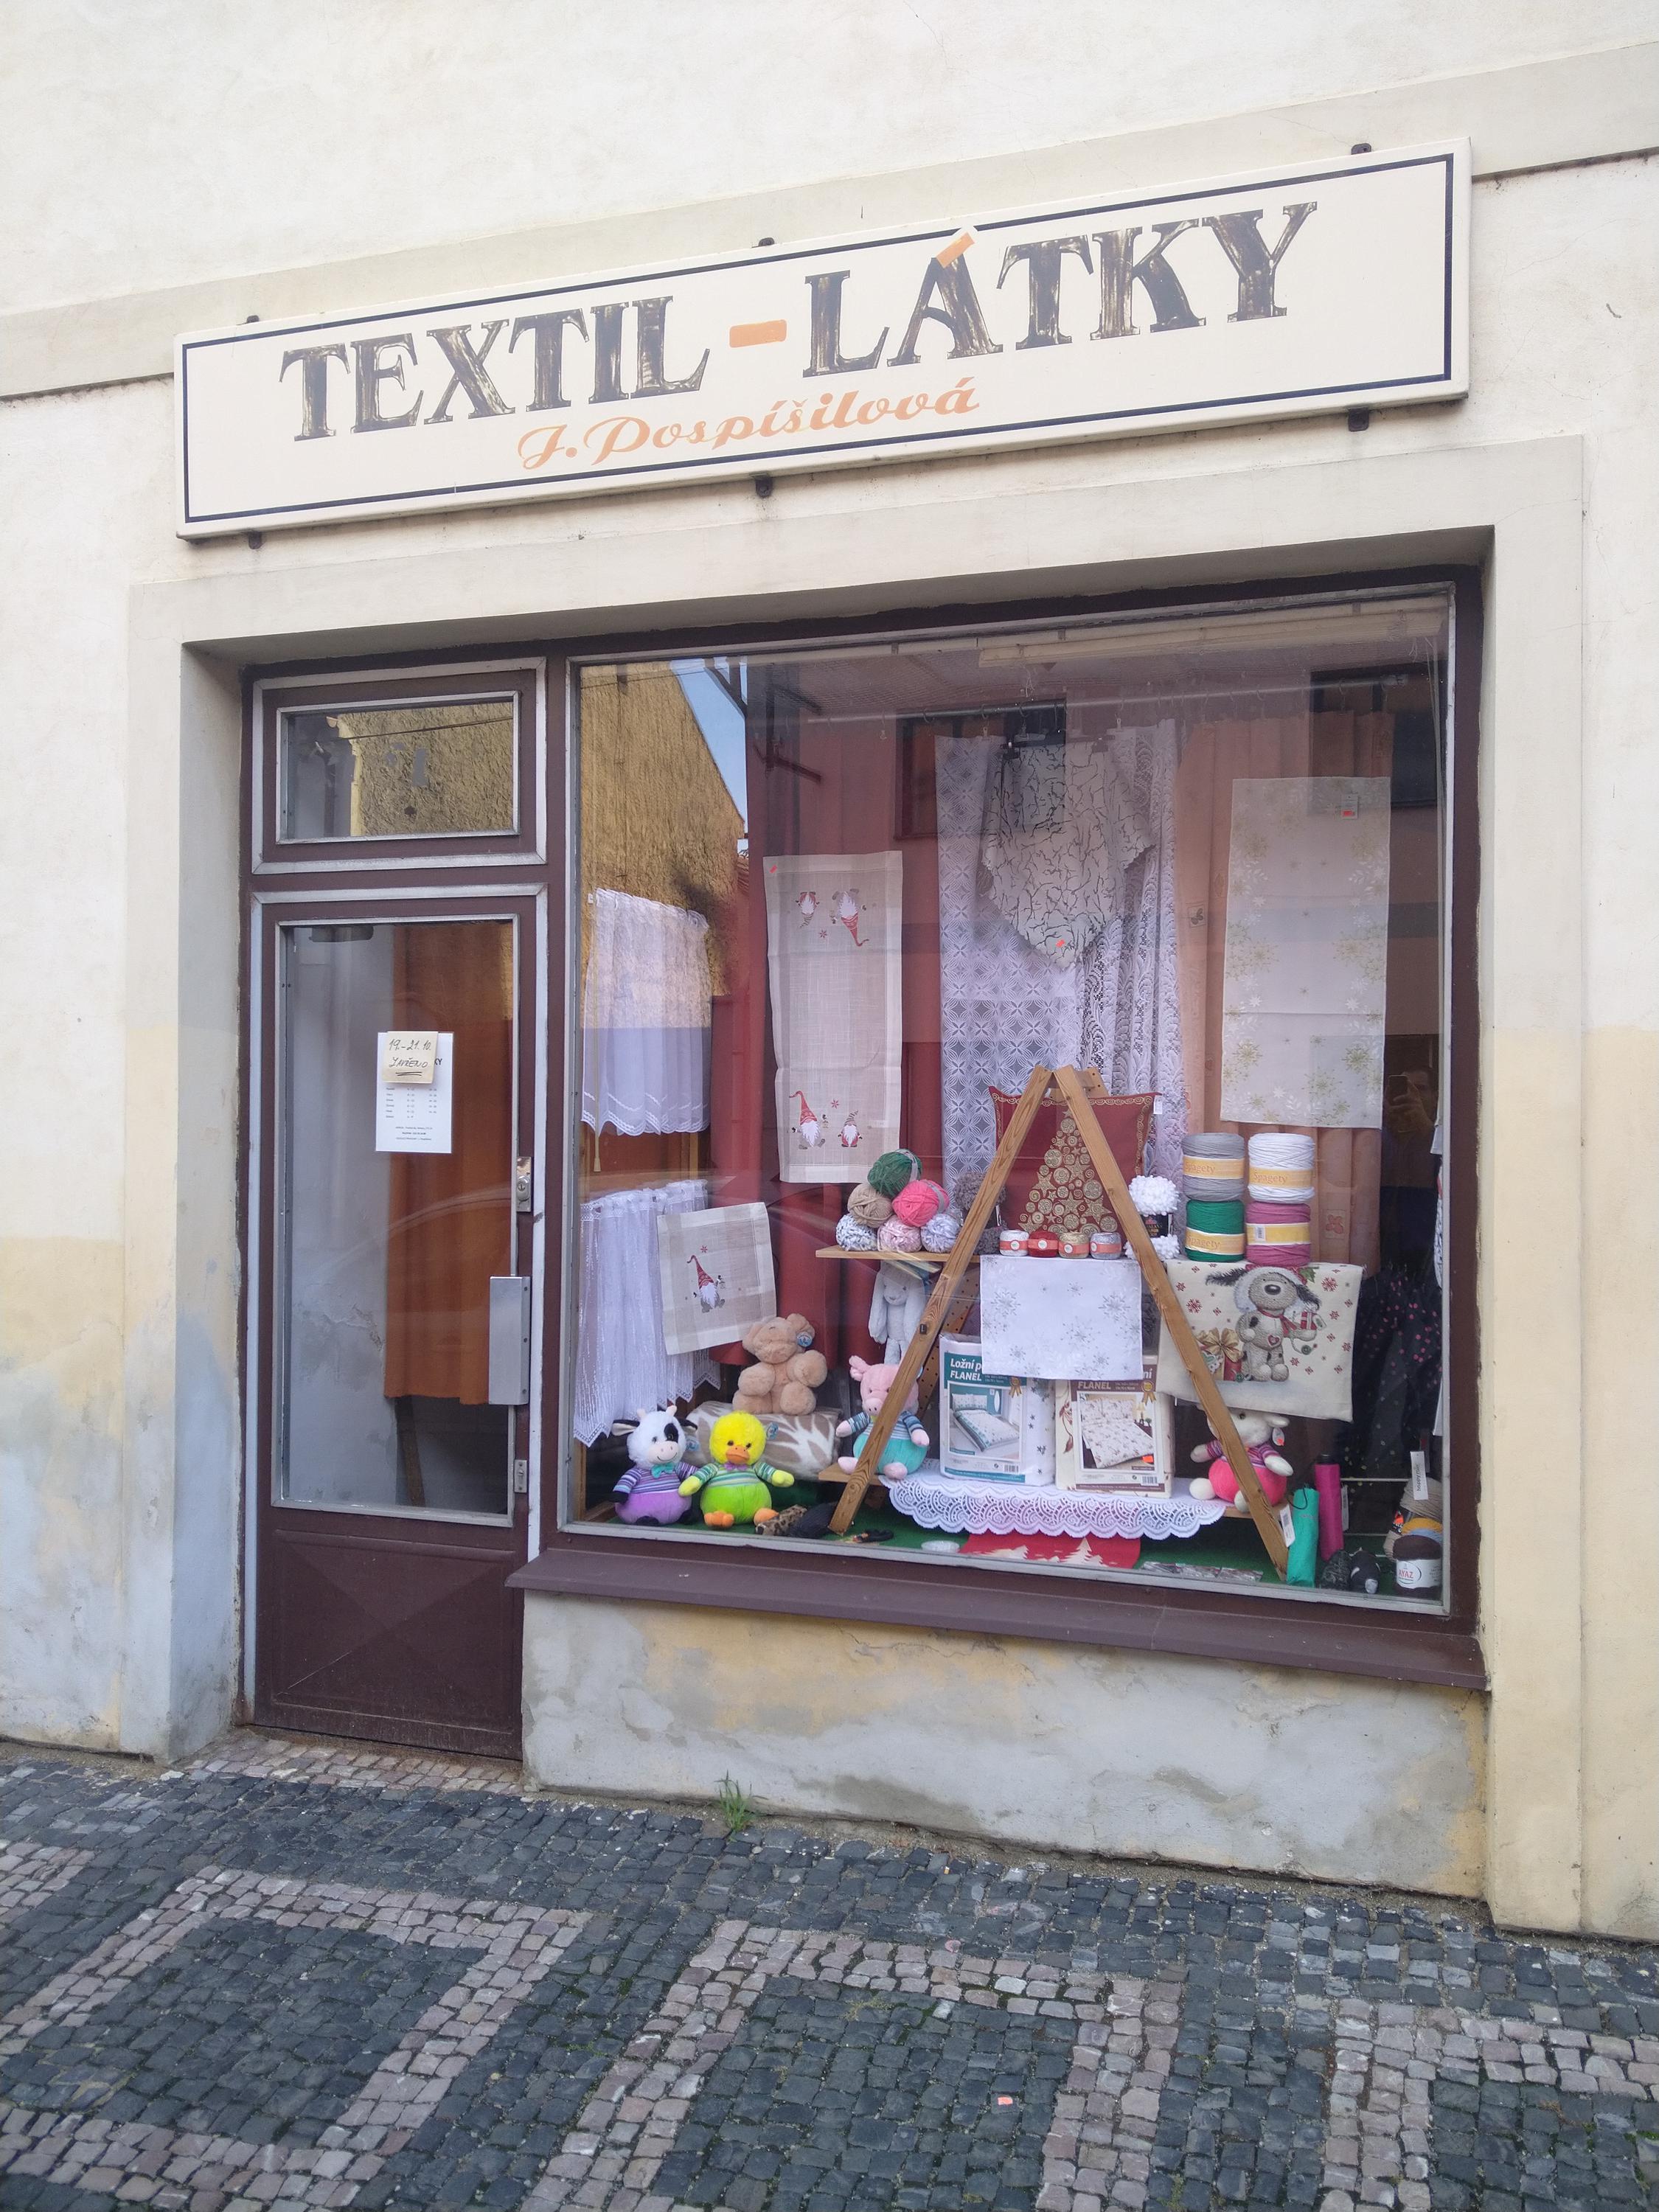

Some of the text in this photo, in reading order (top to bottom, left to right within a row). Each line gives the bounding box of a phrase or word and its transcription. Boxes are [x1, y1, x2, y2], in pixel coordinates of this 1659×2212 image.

[279, 295, 710, 442] TEXTIL
[802, 201, 1318, 379] LÁTKY
[1254, 1170, 1287, 1184] Spagety
[1186, 1233, 1222, 1250] Spagety
[950, 1357, 975, 1370] Ložní
[950, 1370, 982, 1382] FLANEL
[1077, 1380, 1111, 1390] FLANEL
[1398, 1568, 1414, 1579] AYAZ
